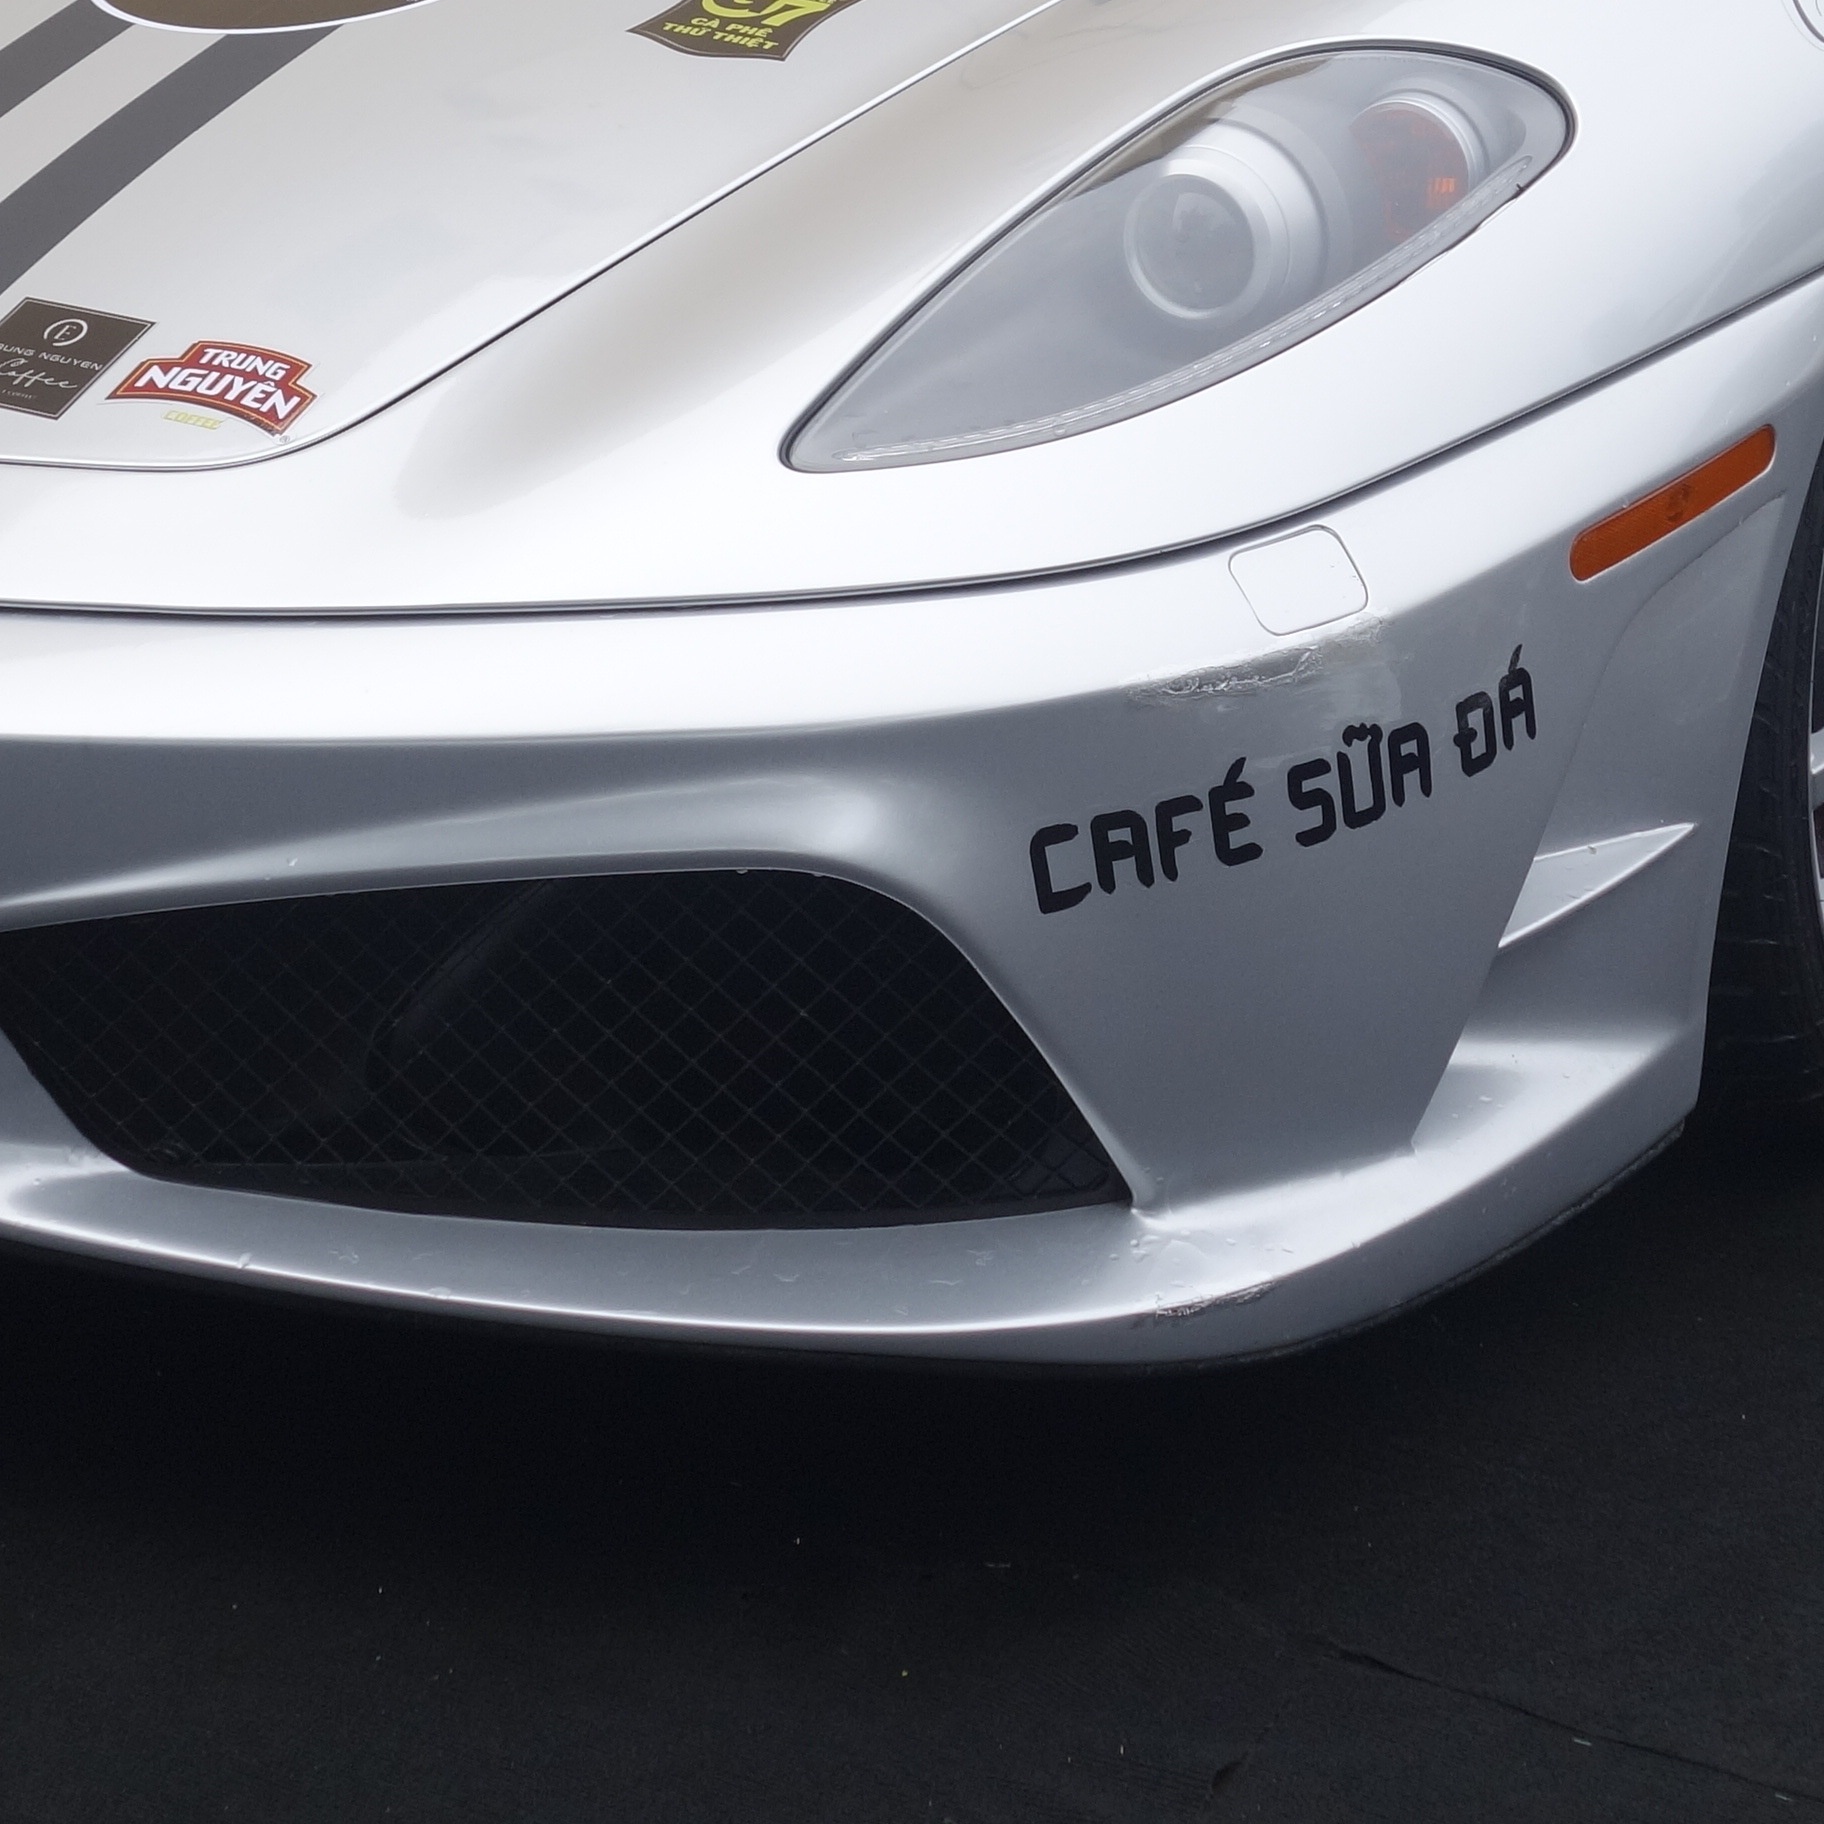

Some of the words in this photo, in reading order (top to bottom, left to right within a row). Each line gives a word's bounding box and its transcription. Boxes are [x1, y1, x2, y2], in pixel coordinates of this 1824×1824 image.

[690, 16, 721, 29] CÀ
[725, 23, 773, 38] PHÊ
[713, 31, 779, 51] THIỆT
[199, 347, 291, 381] TRUNG
[133, 365, 302, 421] NGUYÊN
[1029, 756, 1264, 915] CAFÉ
[1286, 721, 1433, 848] SỮA
[1452, 643, 1537, 778] ĐÁ
